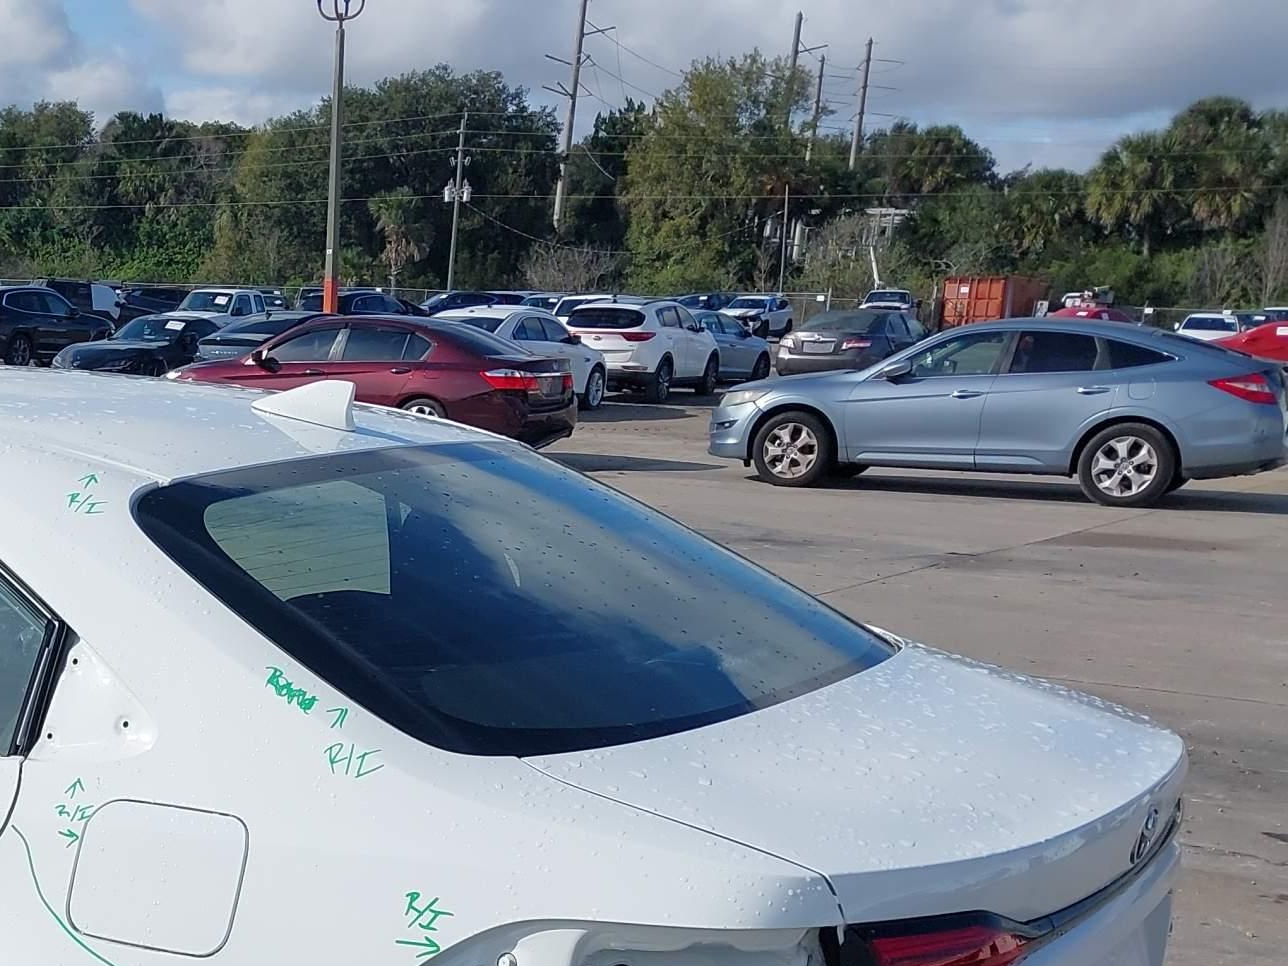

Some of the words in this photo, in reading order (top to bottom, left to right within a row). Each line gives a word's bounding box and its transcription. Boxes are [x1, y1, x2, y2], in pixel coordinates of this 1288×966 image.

[67, 492, 108, 514] R/I
[324, 742, 385, 779] R/I
[54, 804, 95, 822] R/I
[404, 891, 454, 931] R/I
